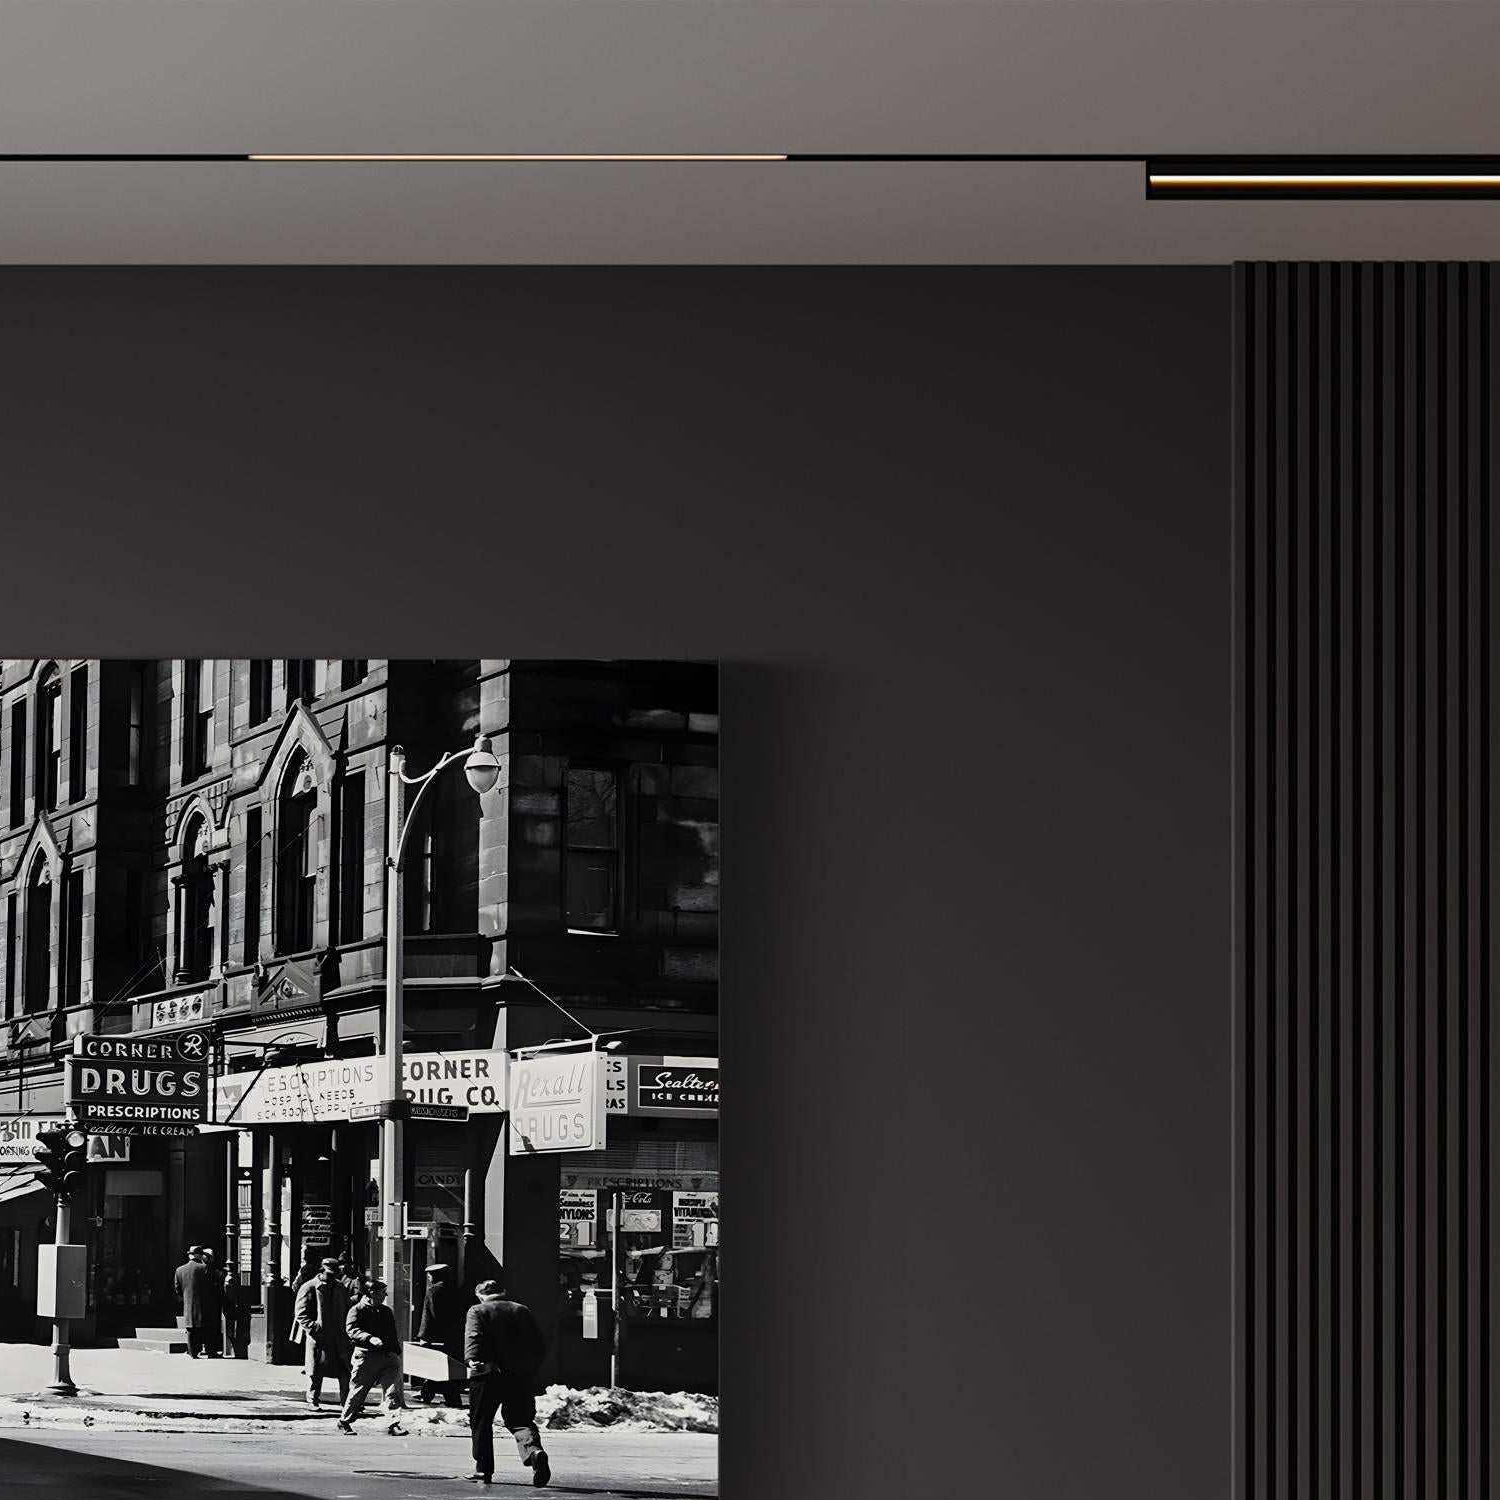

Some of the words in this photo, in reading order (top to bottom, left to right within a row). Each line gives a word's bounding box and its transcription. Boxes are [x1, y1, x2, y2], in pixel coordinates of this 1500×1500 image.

[86, 1041, 173, 1059] CORNER
[80, 1067, 201, 1097] DRUGS
[251, 1064, 374, 1092] ESCRIPTIONS
[514, 1063, 587, 1110] Rexall
[402, 1087, 454, 1105] RUG
[466, 1085, 500, 1106] CO.
[87, 1104, 201, 1120] PRESCRIPTIONS
[142, 1125, 158, 1136] ICE
[160, 1125, 195, 1137] CREAM
